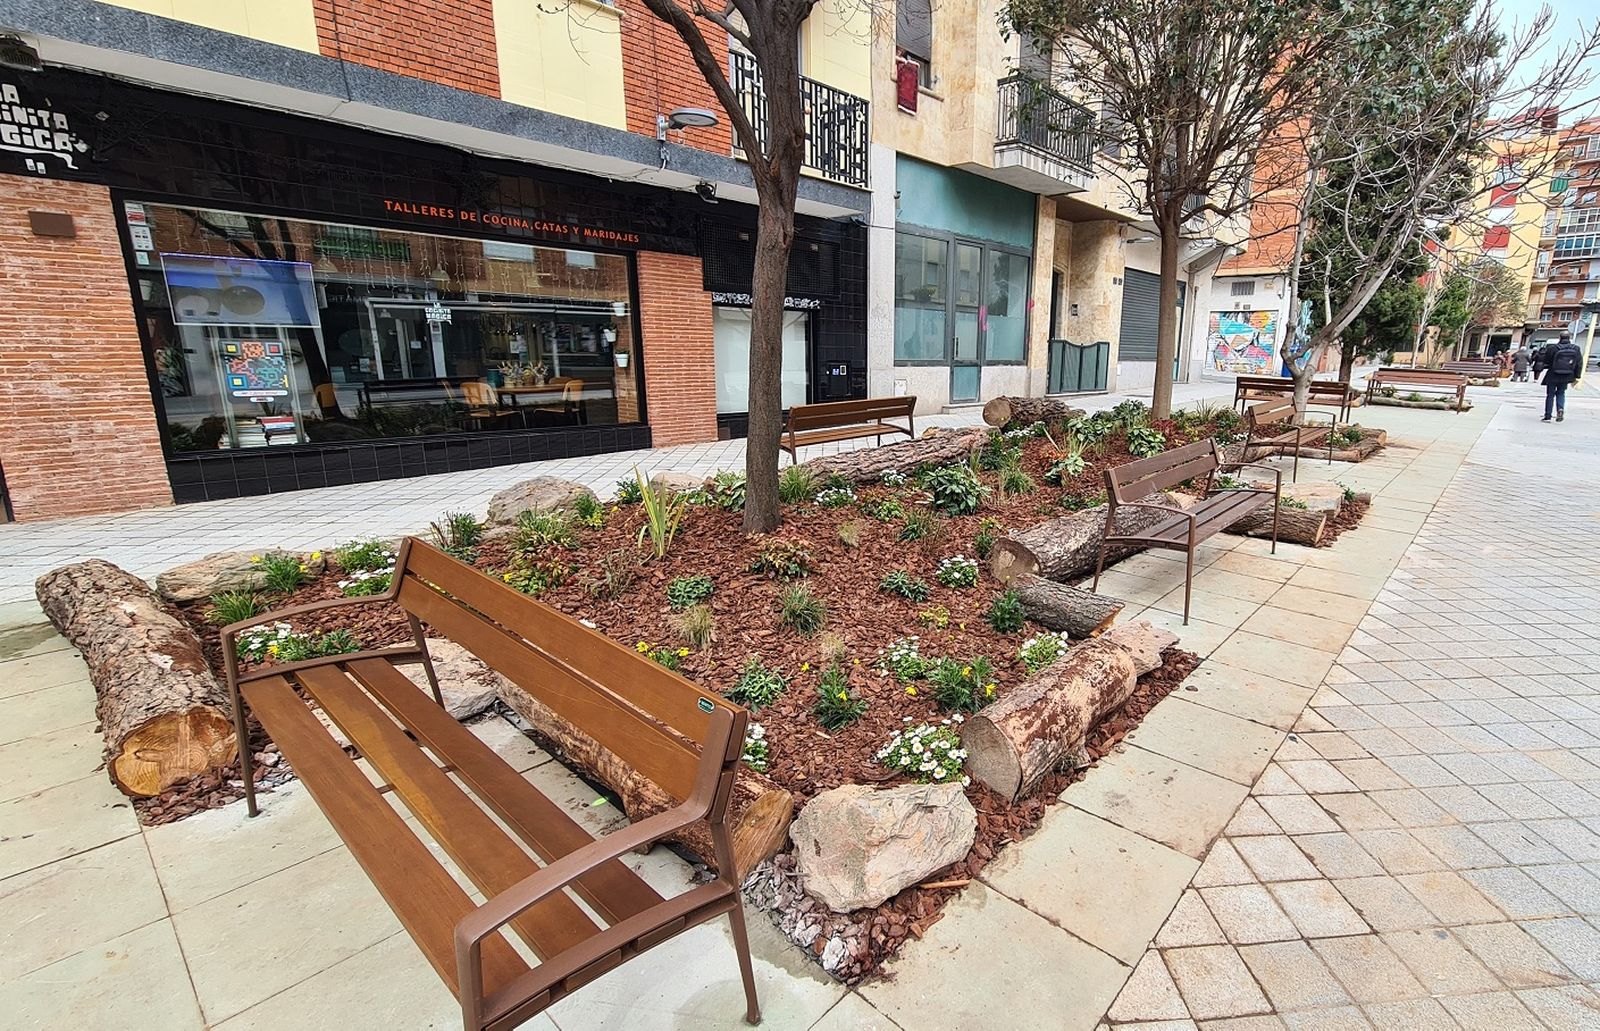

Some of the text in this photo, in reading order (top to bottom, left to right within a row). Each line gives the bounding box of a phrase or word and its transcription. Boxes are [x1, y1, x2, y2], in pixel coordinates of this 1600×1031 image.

[0, 83, 20, 104] A
[0, 104, 69, 130] iNiTA
[0, 123, 73, 152] GiCA
[384, 200, 455, 219] TALLERES
[460, 211, 477, 221] DE
[573, 226, 580, 235] Y
[584, 228, 639, 243] MARIDAJES
